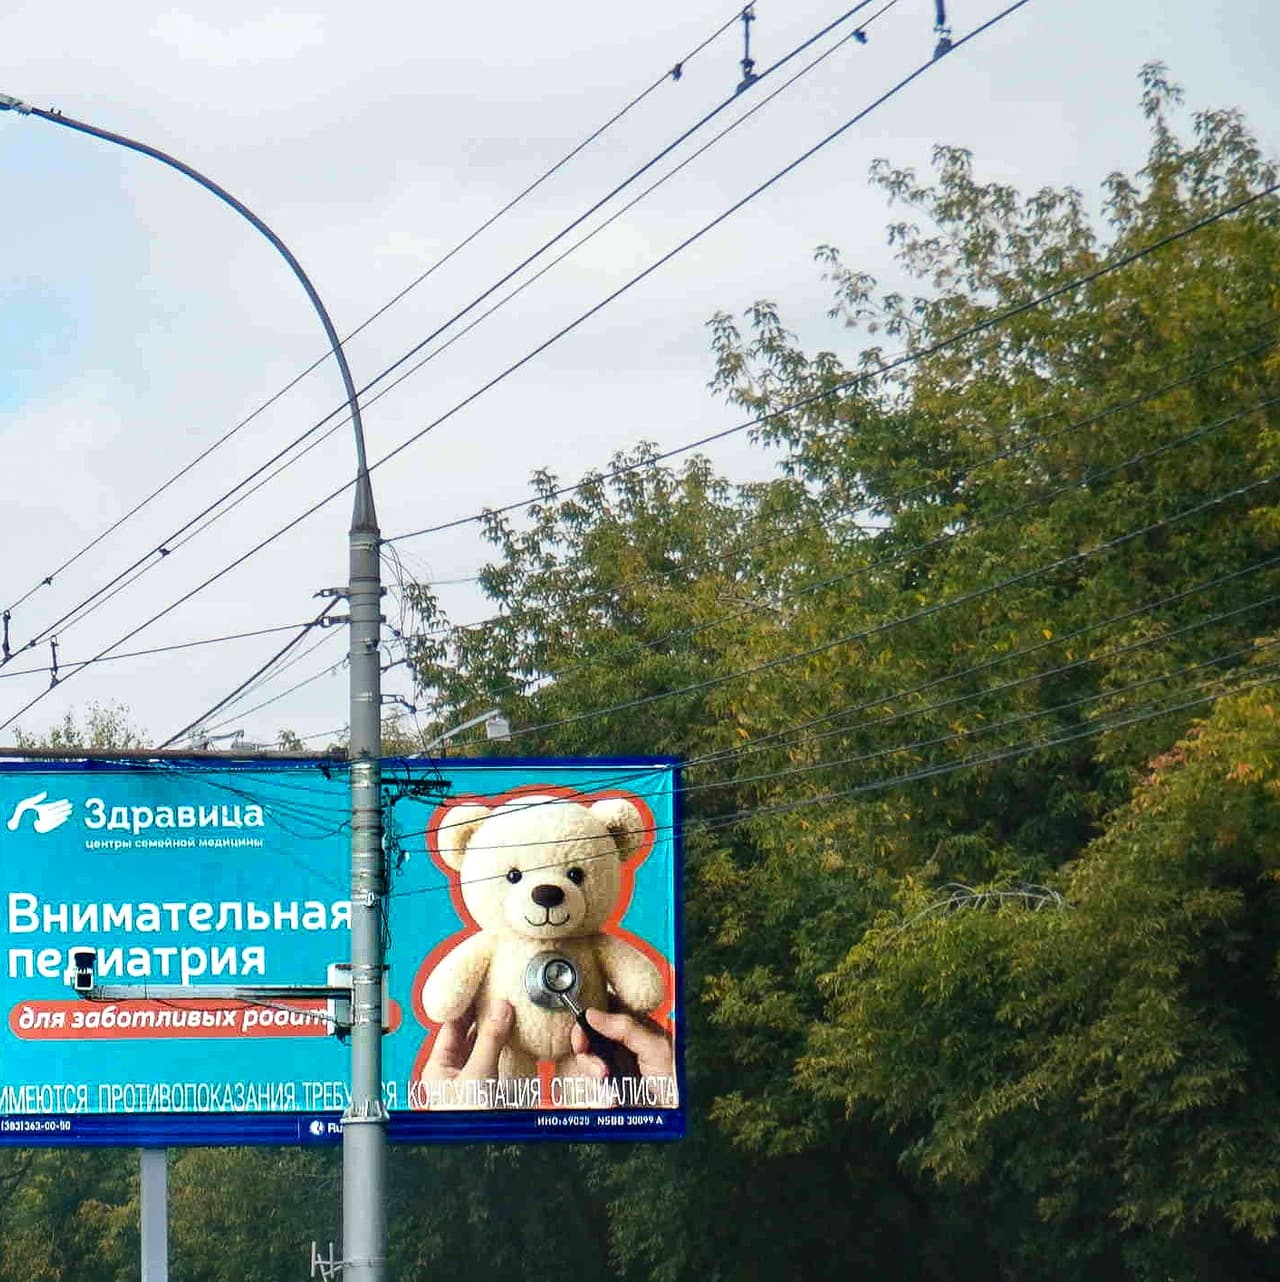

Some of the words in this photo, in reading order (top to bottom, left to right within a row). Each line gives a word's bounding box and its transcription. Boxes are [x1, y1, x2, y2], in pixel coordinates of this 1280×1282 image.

[84, 797, 265, 835] Здравица
[8, 892, 353, 934] Внимательная
[19, 1007, 65, 1030] для
[71, 1007, 236, 1029] заботливых
[407, 1079, 540, 1109] КОНСУЛЬТАЦИЯ
[551, 1077, 677, 1107] СПЕЦИАЛИСТА
